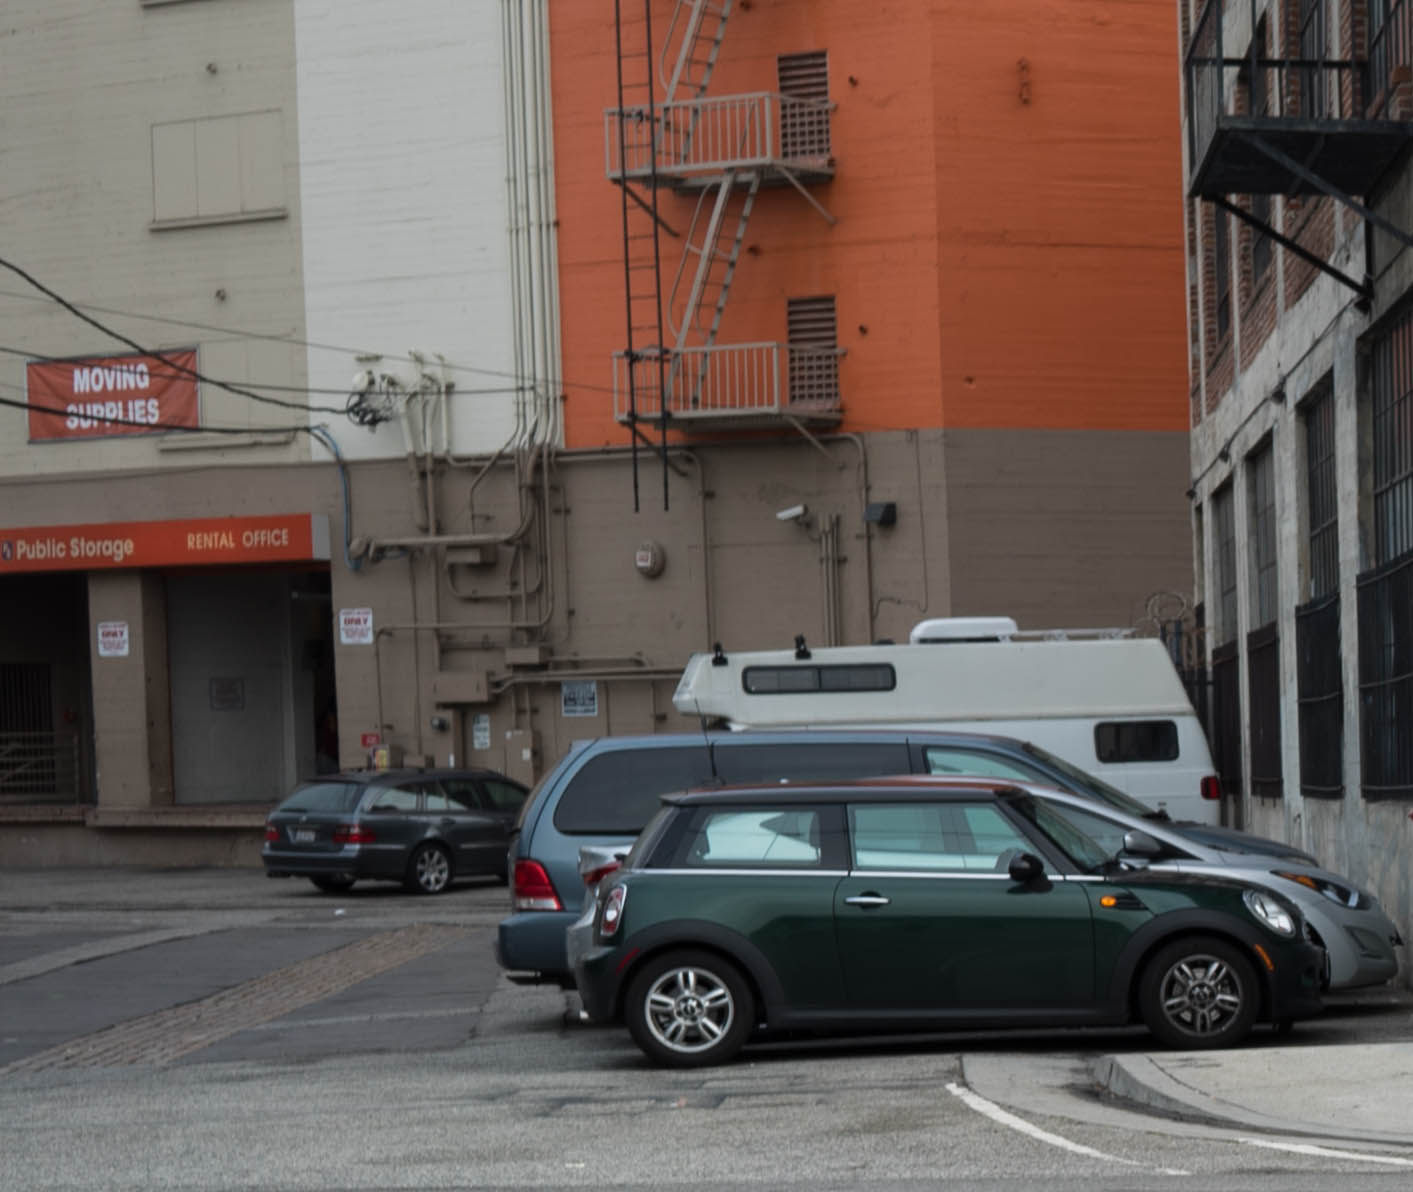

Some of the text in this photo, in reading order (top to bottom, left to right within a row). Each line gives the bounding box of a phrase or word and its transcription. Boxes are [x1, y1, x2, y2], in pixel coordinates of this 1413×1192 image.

[73, 363, 150, 394] MOVING
[66, 397, 160, 430] SUPPLIES
[16, 536, 134, 562] Public Storage
[187, 528, 289, 550] RENTAL OFFICE
